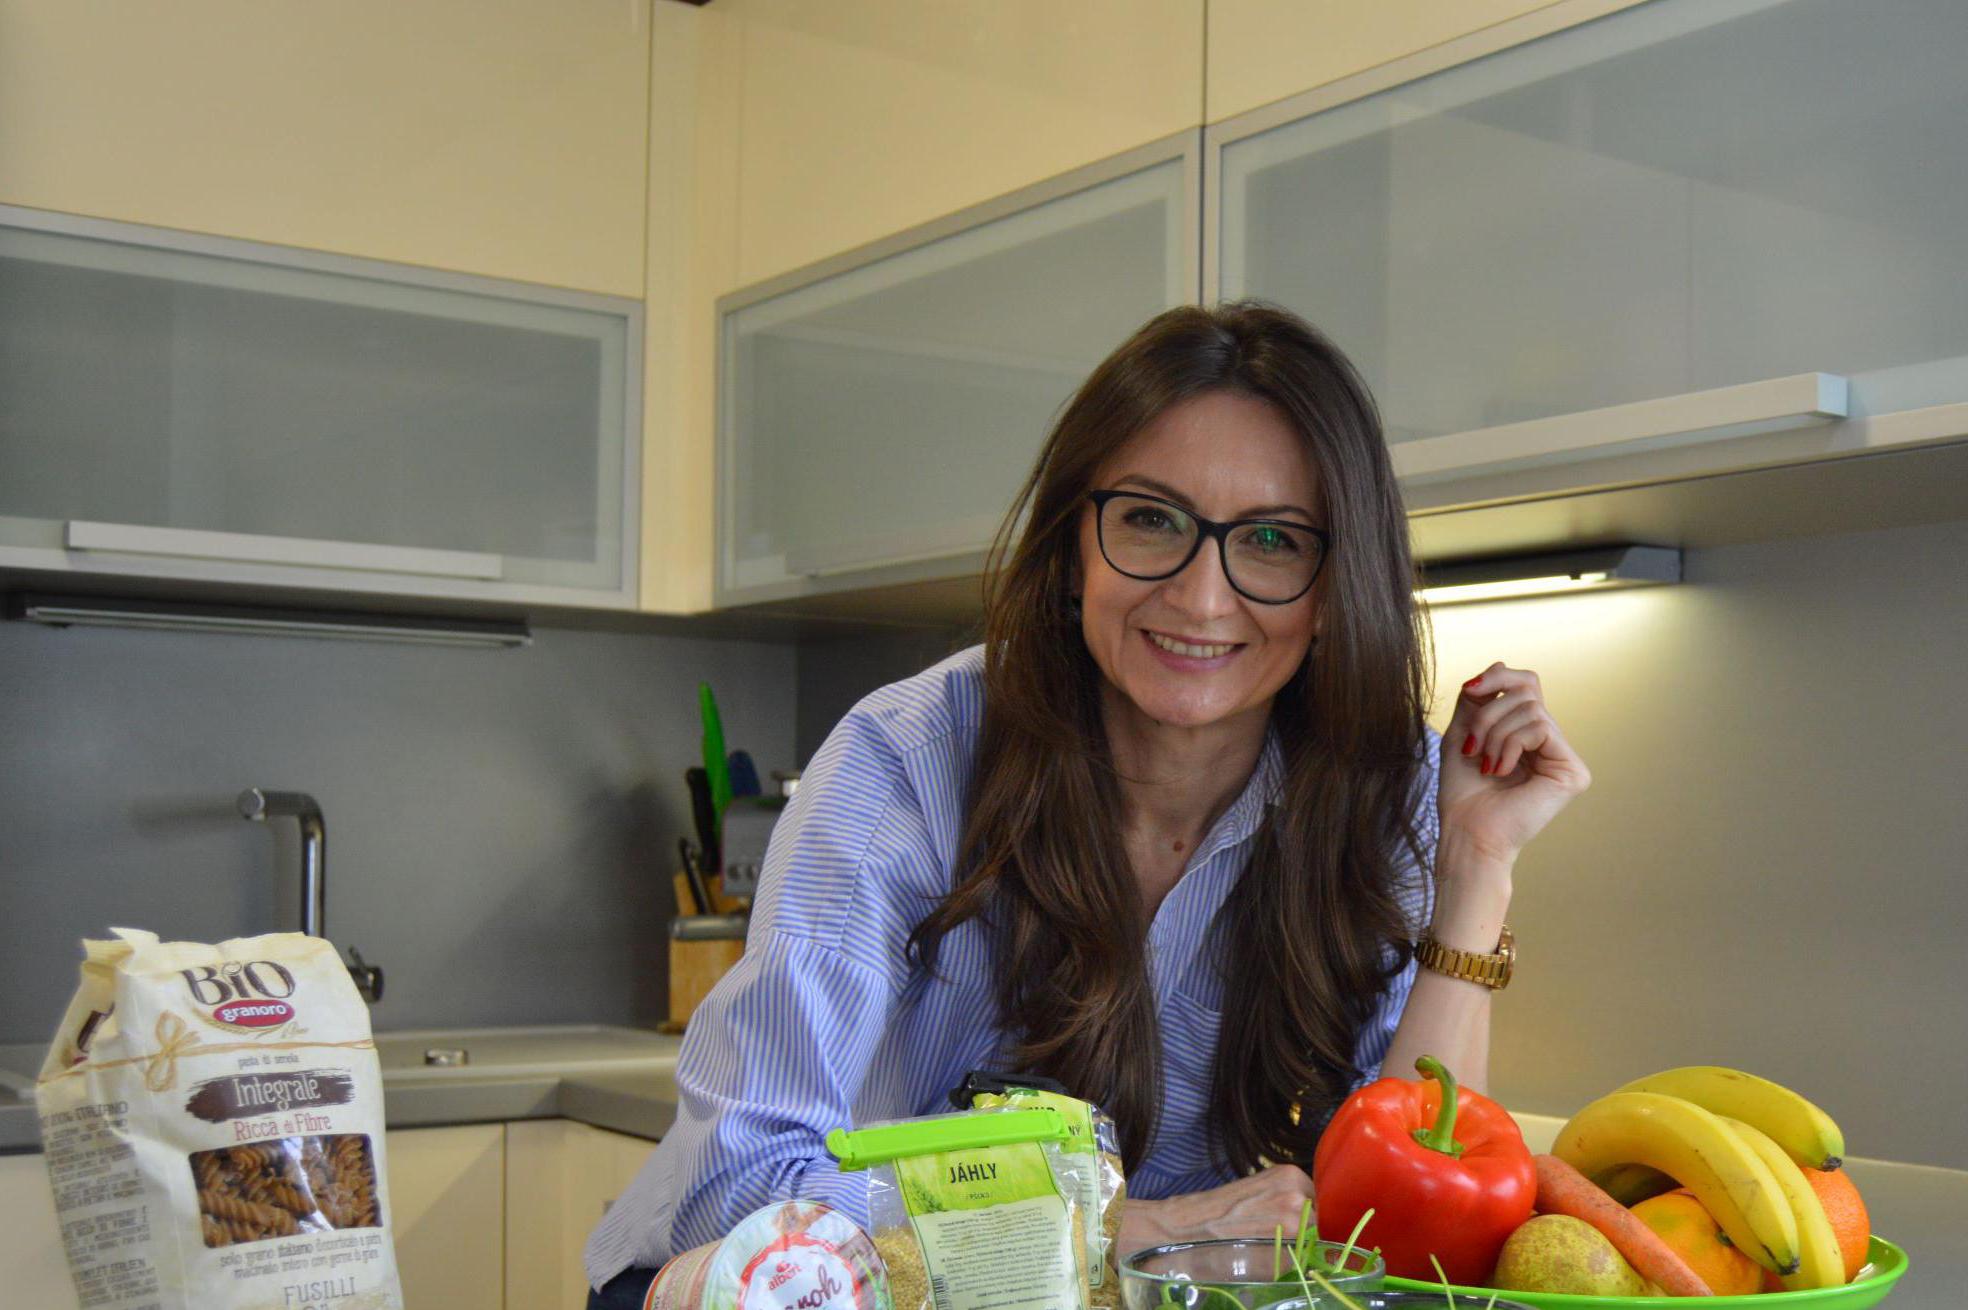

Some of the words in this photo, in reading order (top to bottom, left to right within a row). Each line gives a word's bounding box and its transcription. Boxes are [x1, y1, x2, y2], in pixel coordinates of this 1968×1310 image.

[221, 1004, 287, 1022] granoro
[232, 1073, 321, 1112] Integrale
[234, 1119, 279, 1141] Ricca
[295, 1113, 332, 1132] Fibre
[950, 1162, 997, 1184] JÁHLY
[284, 1277, 356, 1305] FUSILLI
